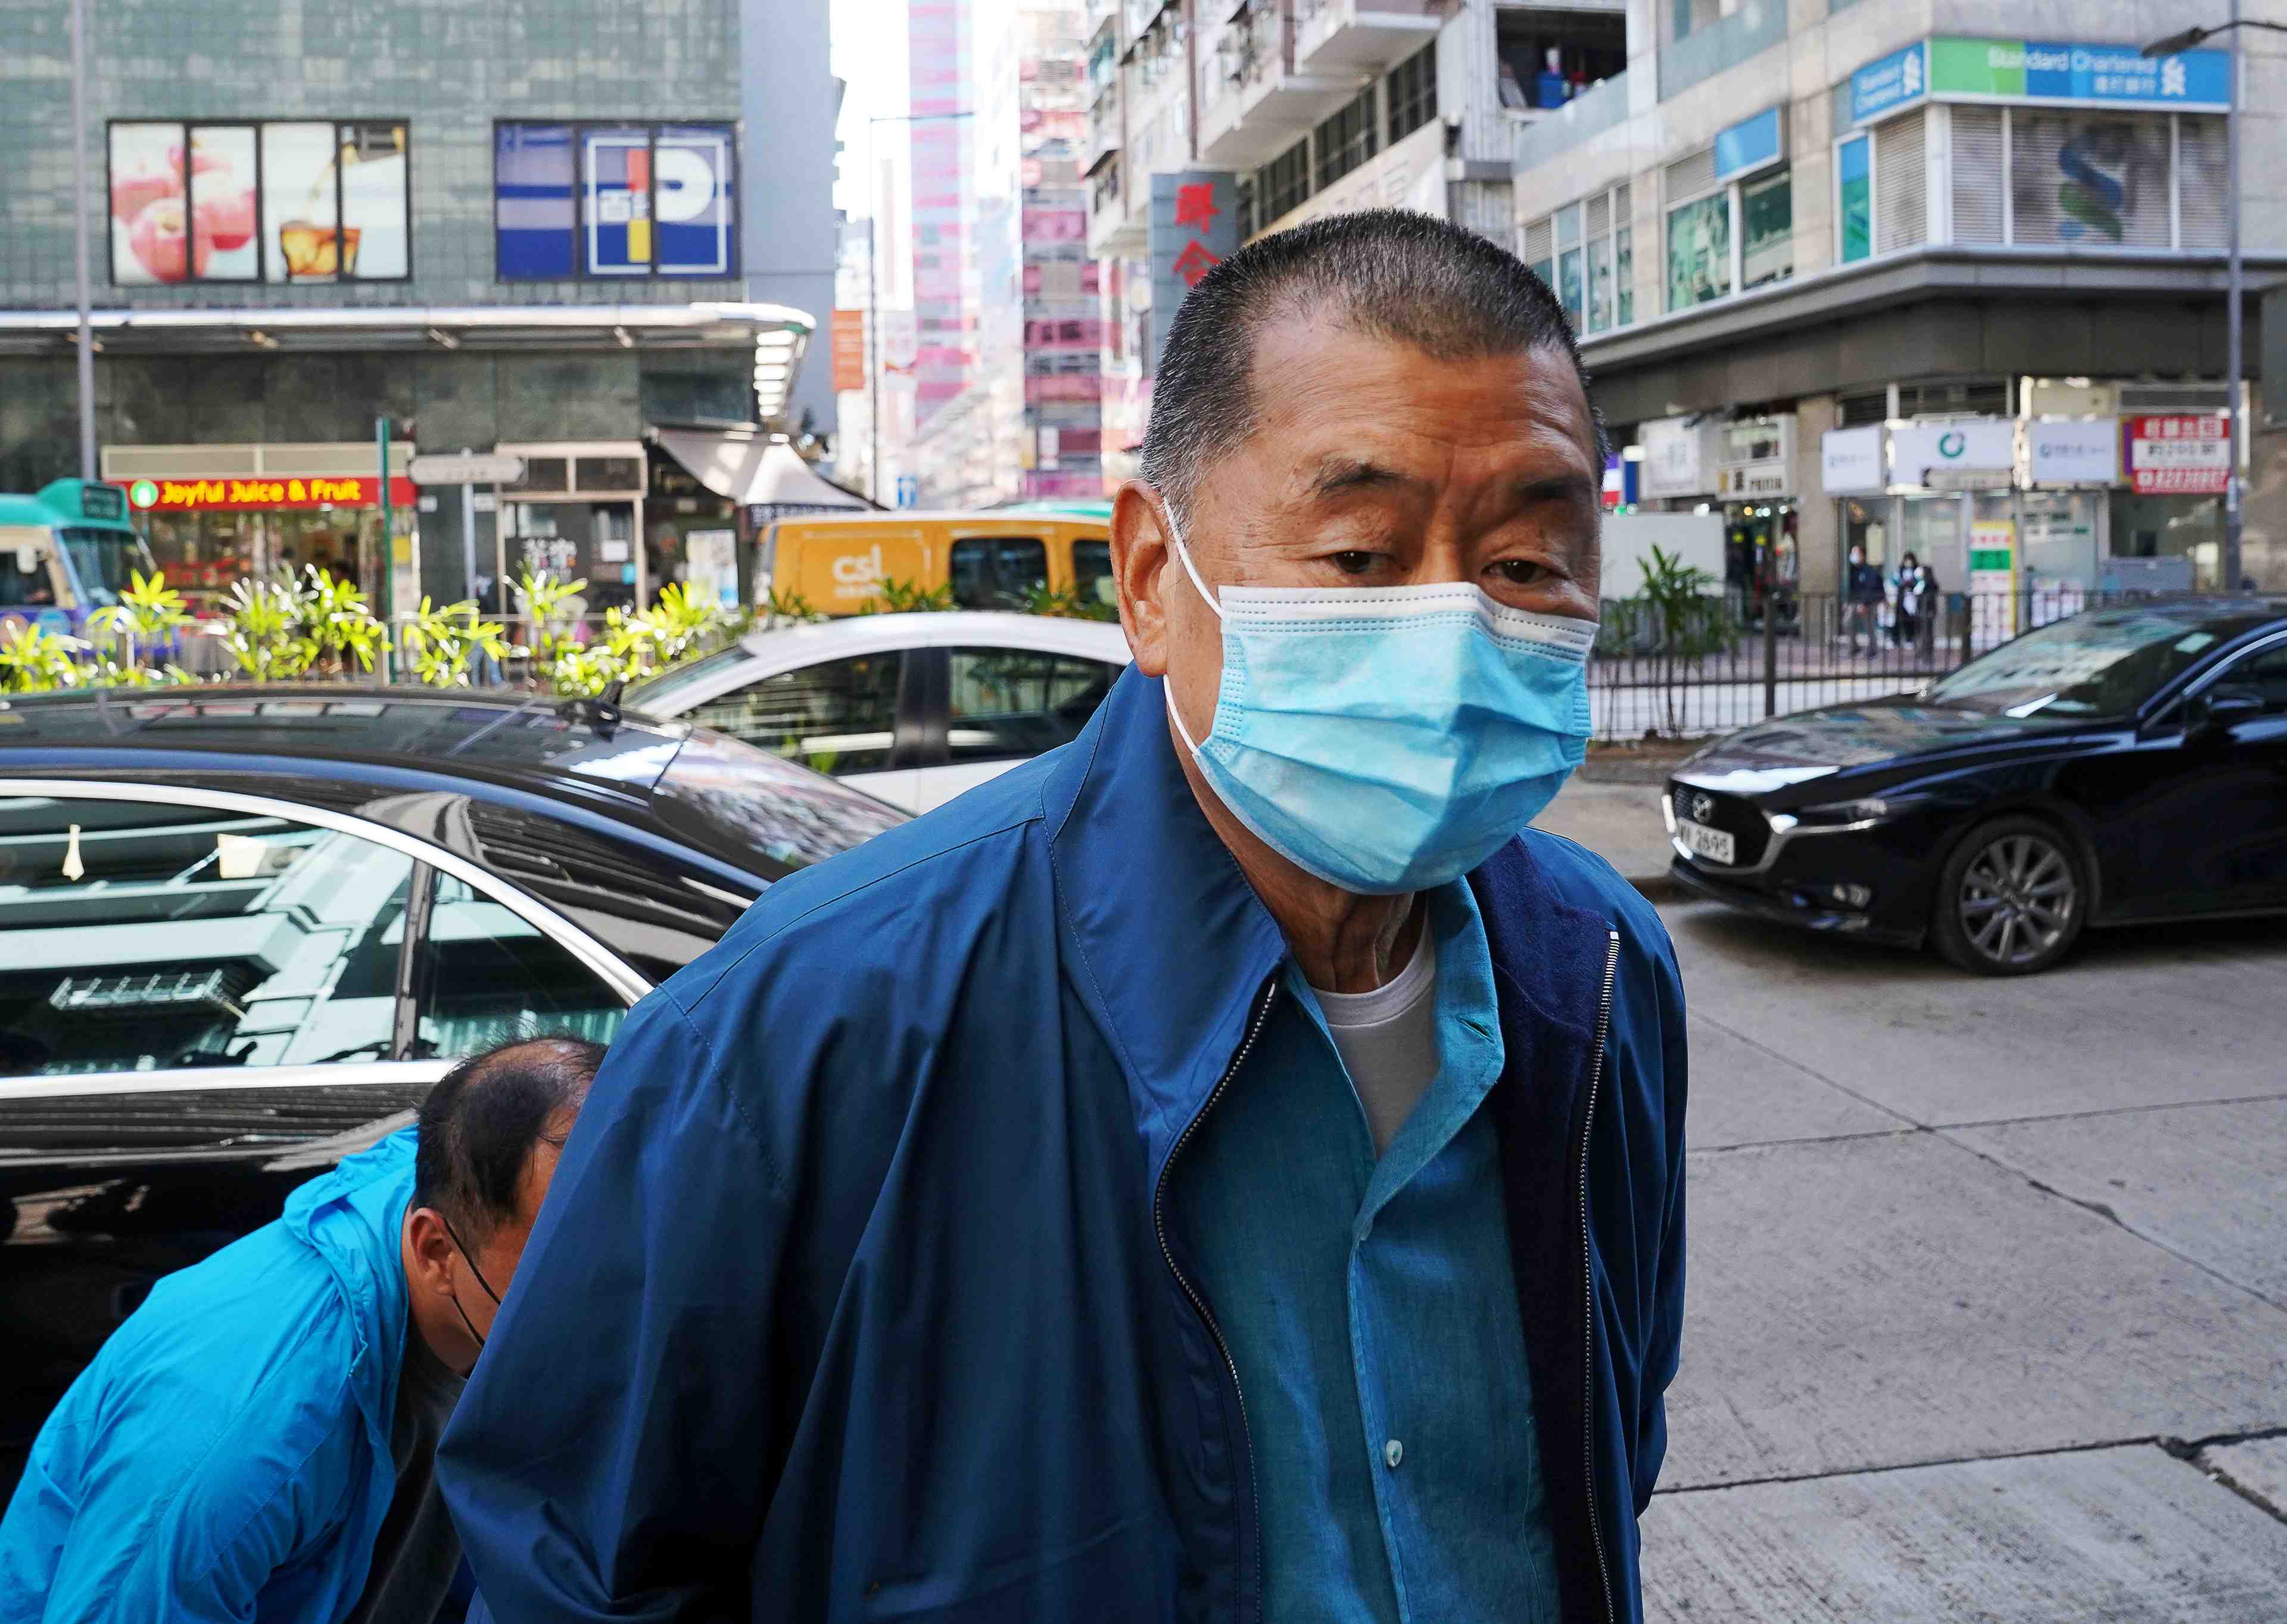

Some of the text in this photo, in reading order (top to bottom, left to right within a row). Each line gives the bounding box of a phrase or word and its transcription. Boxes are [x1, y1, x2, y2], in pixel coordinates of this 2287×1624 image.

[162, 479, 361, 507] Joyful Juice & Fruit
[833, 544, 883, 582] csl
